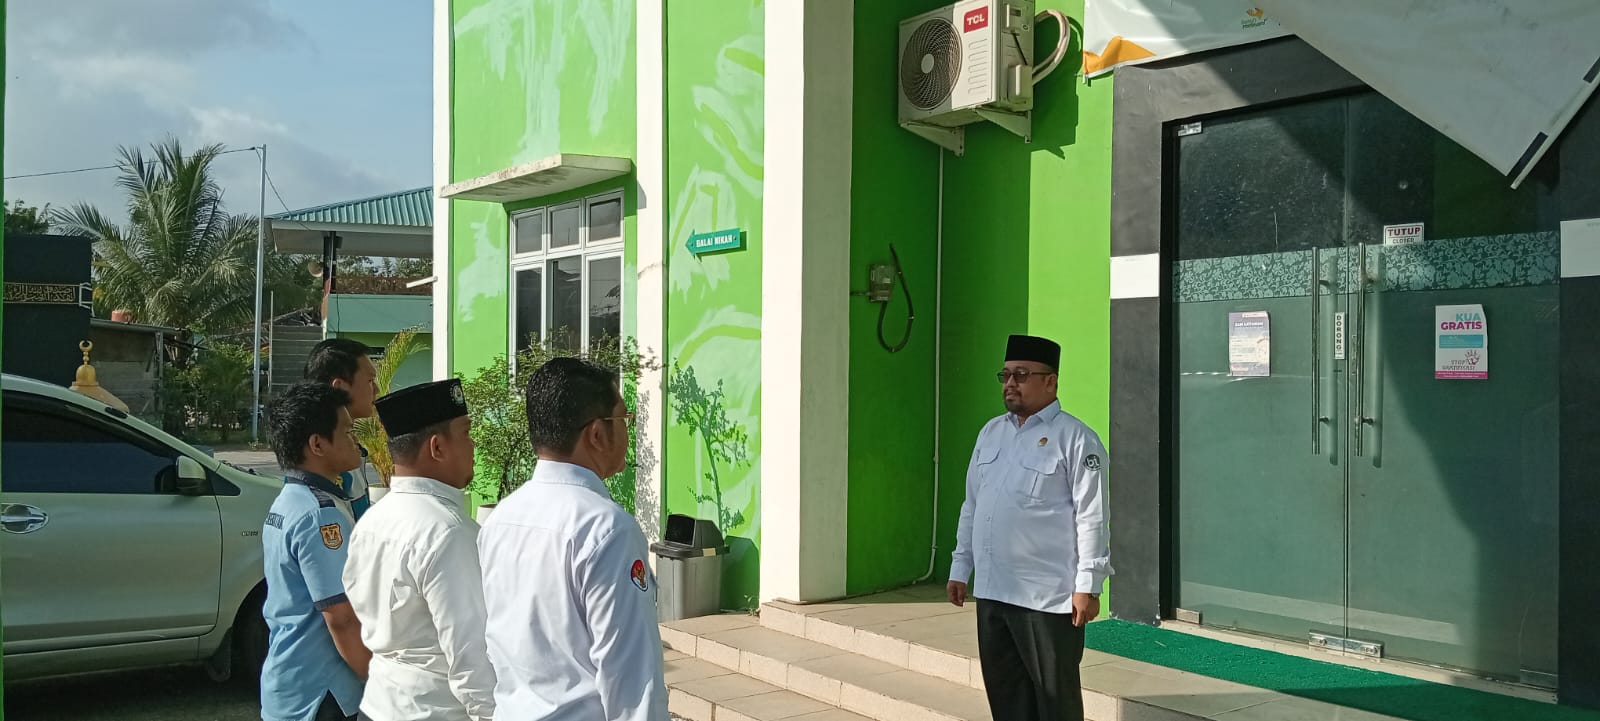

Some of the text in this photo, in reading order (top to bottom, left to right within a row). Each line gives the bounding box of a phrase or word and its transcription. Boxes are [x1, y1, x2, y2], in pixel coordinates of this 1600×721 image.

[967, 13, 985, 26] TCL
[1387, 226, 1421, 237] TUTUP
[696, 234, 733, 248] BALAI NIKAH
[1455, 312, 1482, 321] KUA
[1440, 321, 1483, 331] GRATIS
